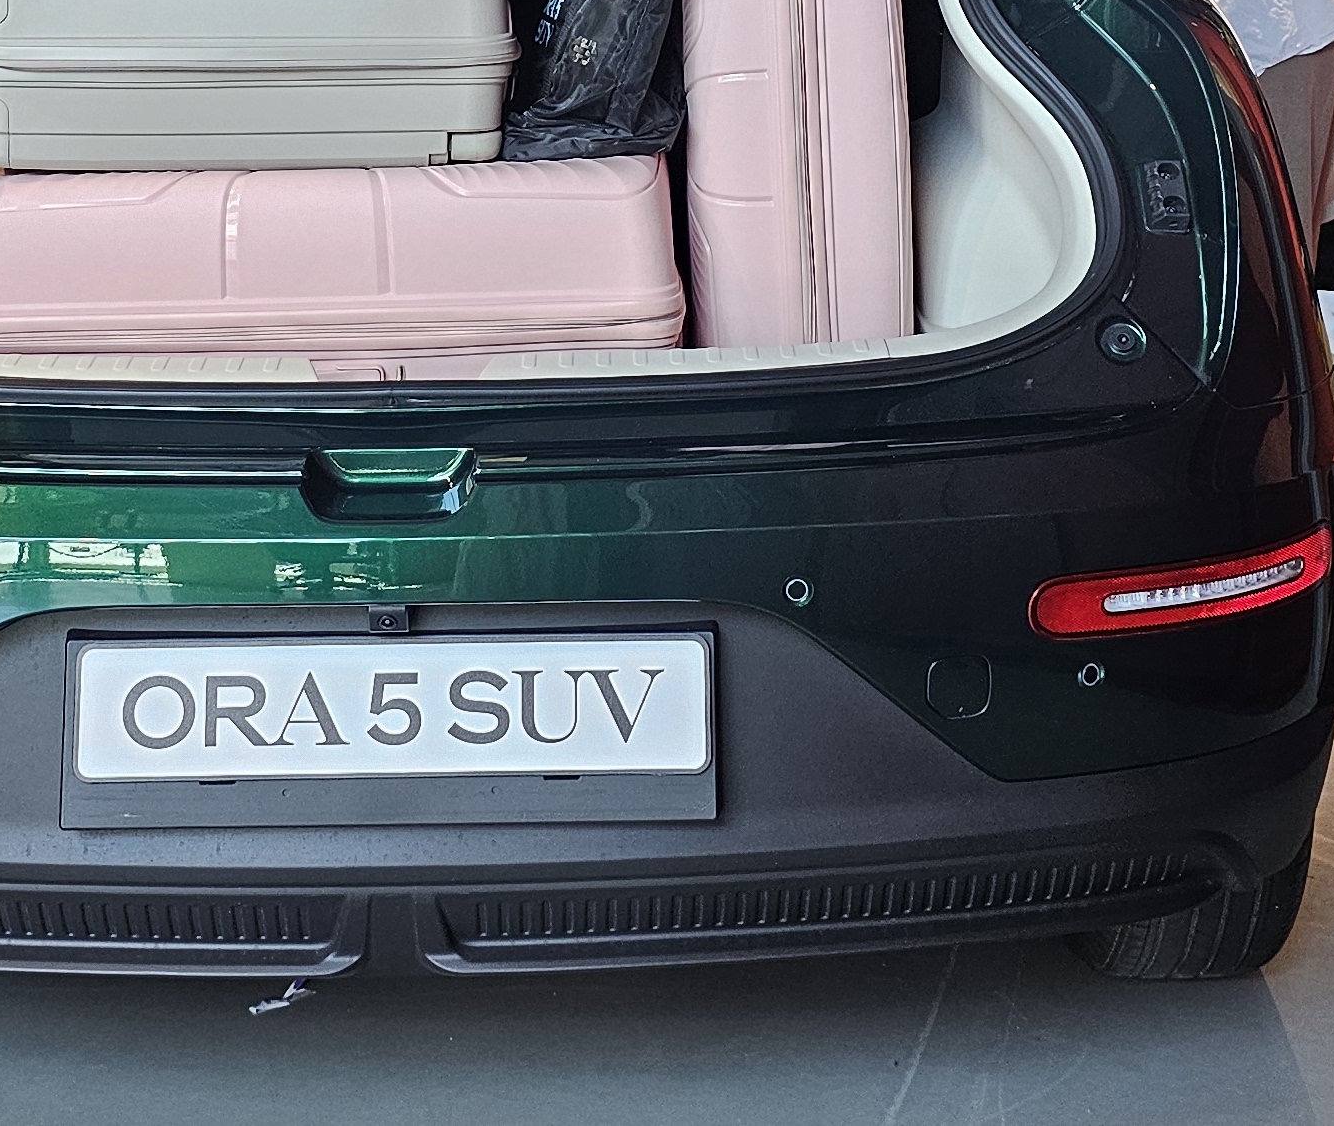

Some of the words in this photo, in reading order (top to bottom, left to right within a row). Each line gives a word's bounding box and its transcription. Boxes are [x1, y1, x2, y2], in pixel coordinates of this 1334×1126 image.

[122, 670, 351, 750] ORA
[366, 672, 423, 746] 5
[447, 667, 666, 745] SUV
